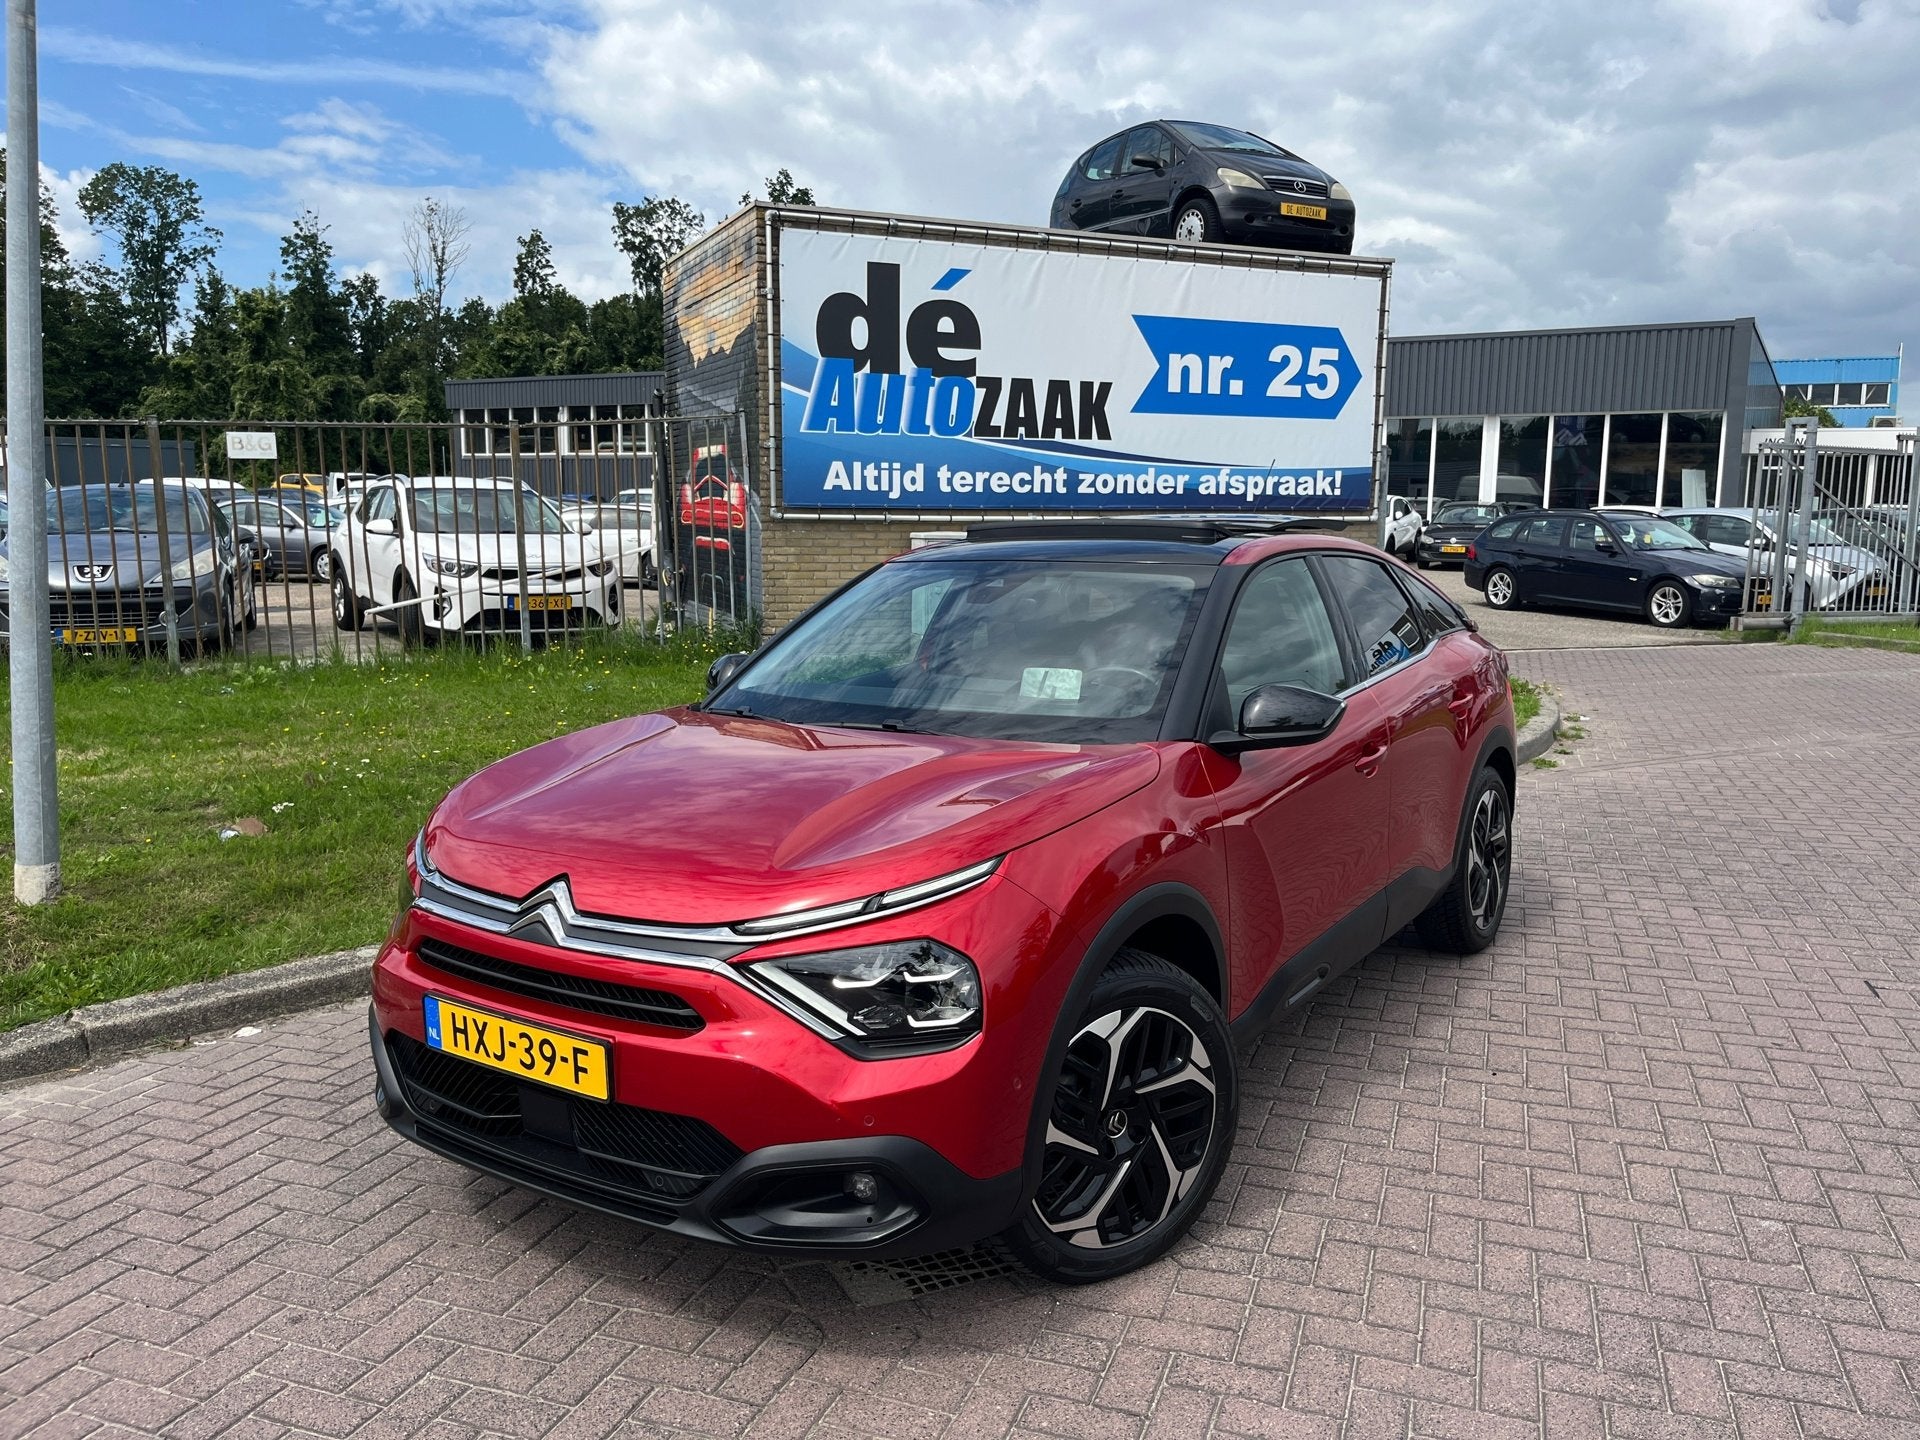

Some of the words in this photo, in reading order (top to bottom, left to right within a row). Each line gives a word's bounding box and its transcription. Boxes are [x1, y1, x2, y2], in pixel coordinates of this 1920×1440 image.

[1286, 204, 1294, 215] DE
[1296, 206, 1322, 218] AUTOZAAK
[816, 261, 982, 377] dé
[1167, 353, 1244, 396] nr.
[1265, 344, 1340, 400] 25
[231, 434, 273, 451] B&G
[823, 461, 925, 499] Altijd
[937, 465, 1067, 495] terecht
[1078, 467, 1190, 496] zonder
[1198, 469, 1343, 502] afspraak!
[428, 1026, 440, 1040] NL
[451, 1011, 589, 1085] HXJ-39-F
